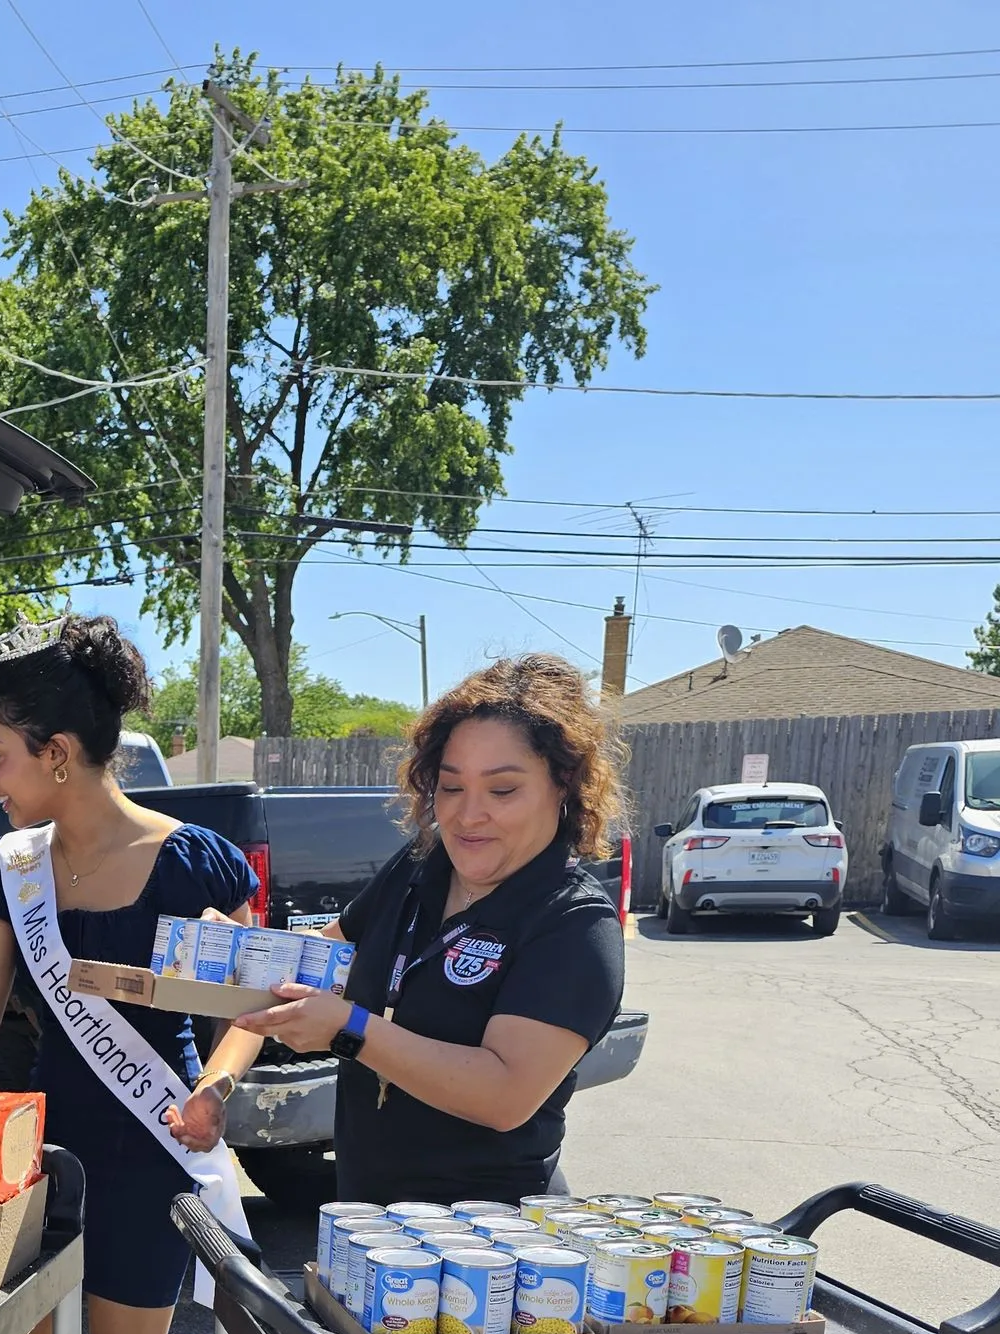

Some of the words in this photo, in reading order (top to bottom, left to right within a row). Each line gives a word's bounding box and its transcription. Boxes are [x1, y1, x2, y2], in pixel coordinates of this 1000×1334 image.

[467, 939, 507, 954] LEYDEN
[454, 954, 485, 972] 175
[23, 901, 48, 964] Miss
[41, 961, 152, 1099] Heartland's
[751, 1255, 786, 1266] Nutrition
[787, 1259, 808, 1267] Facts
[385, 1275, 409, 1285] Great
[518, 1270, 538, 1281] Great
[749, 1277, 774, 1286] Calories
[387, 1296, 416, 1306] Whole
[518, 1292, 545, 1304] Whole
[546, 1296, 574, 1306] Kernel
